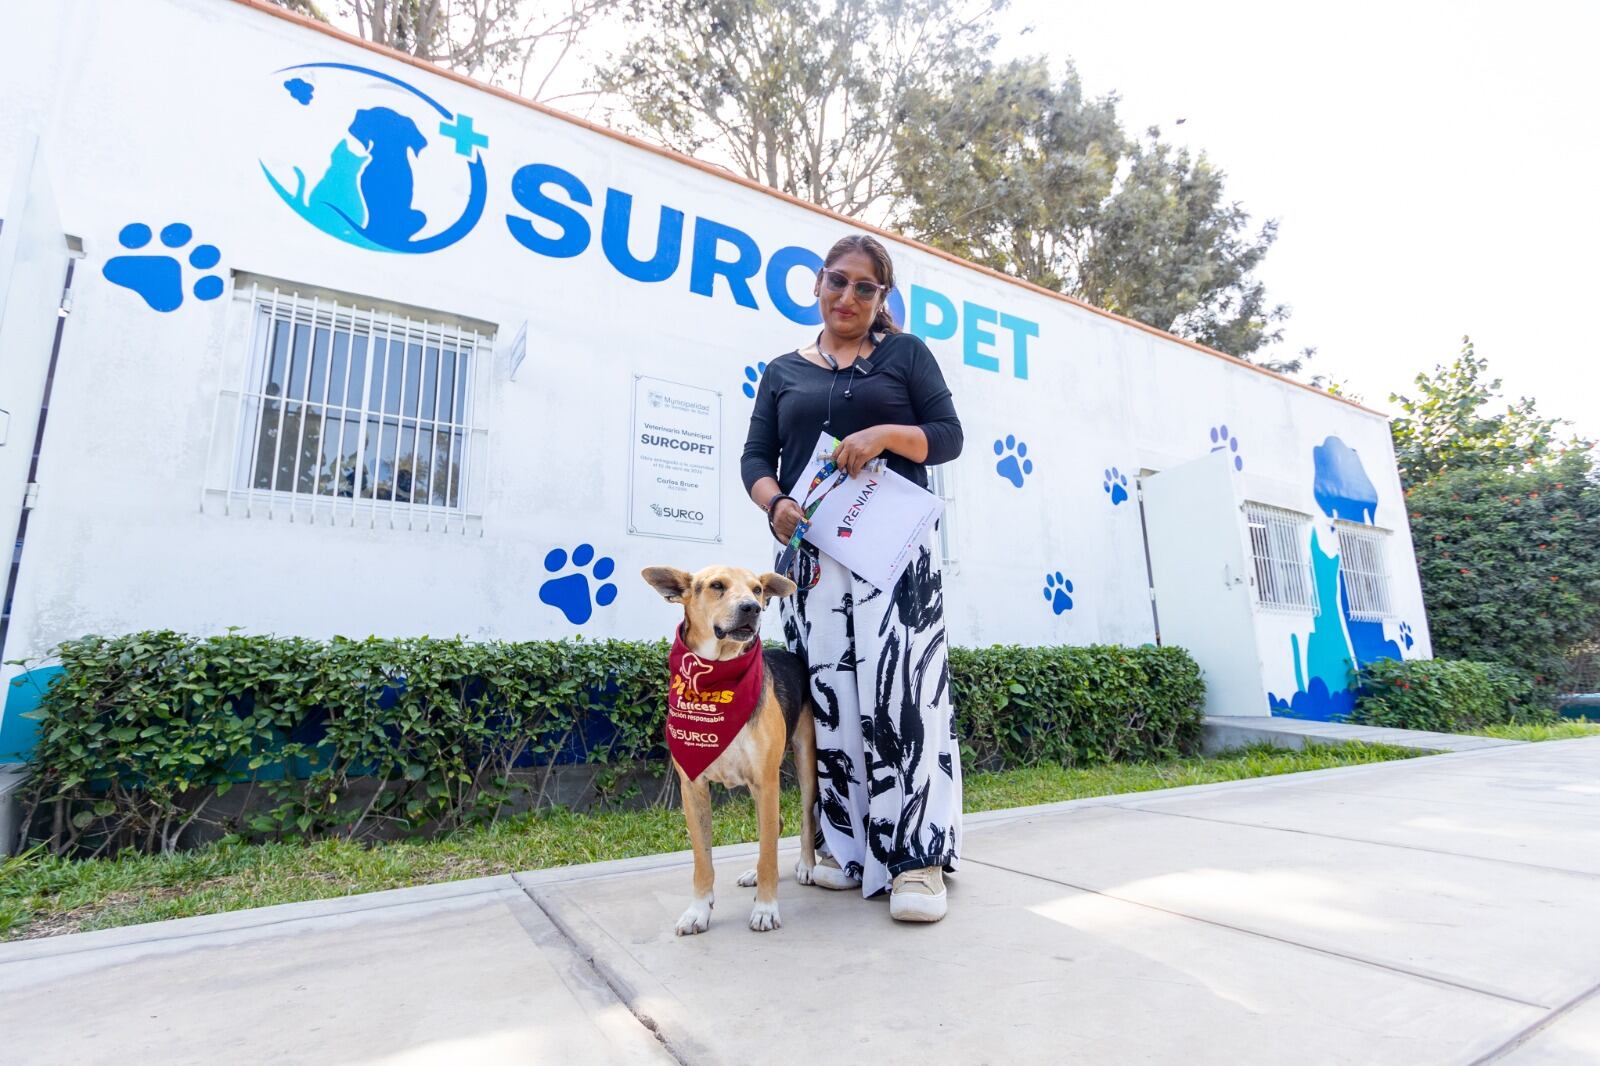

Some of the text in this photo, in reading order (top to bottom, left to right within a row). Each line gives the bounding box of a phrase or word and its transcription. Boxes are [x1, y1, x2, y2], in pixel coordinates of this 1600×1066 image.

[506, 163, 1040, 381] SURCPET
[641, 433, 715, 455] SURCOPET
[680, 480, 699, 489] Bruce
[842, 480, 878, 526] RENIAN
[663, 507, 704, 521] SURCO
[687, 714, 725, 723] responsable
[676, 729, 719, 743] SURCO
